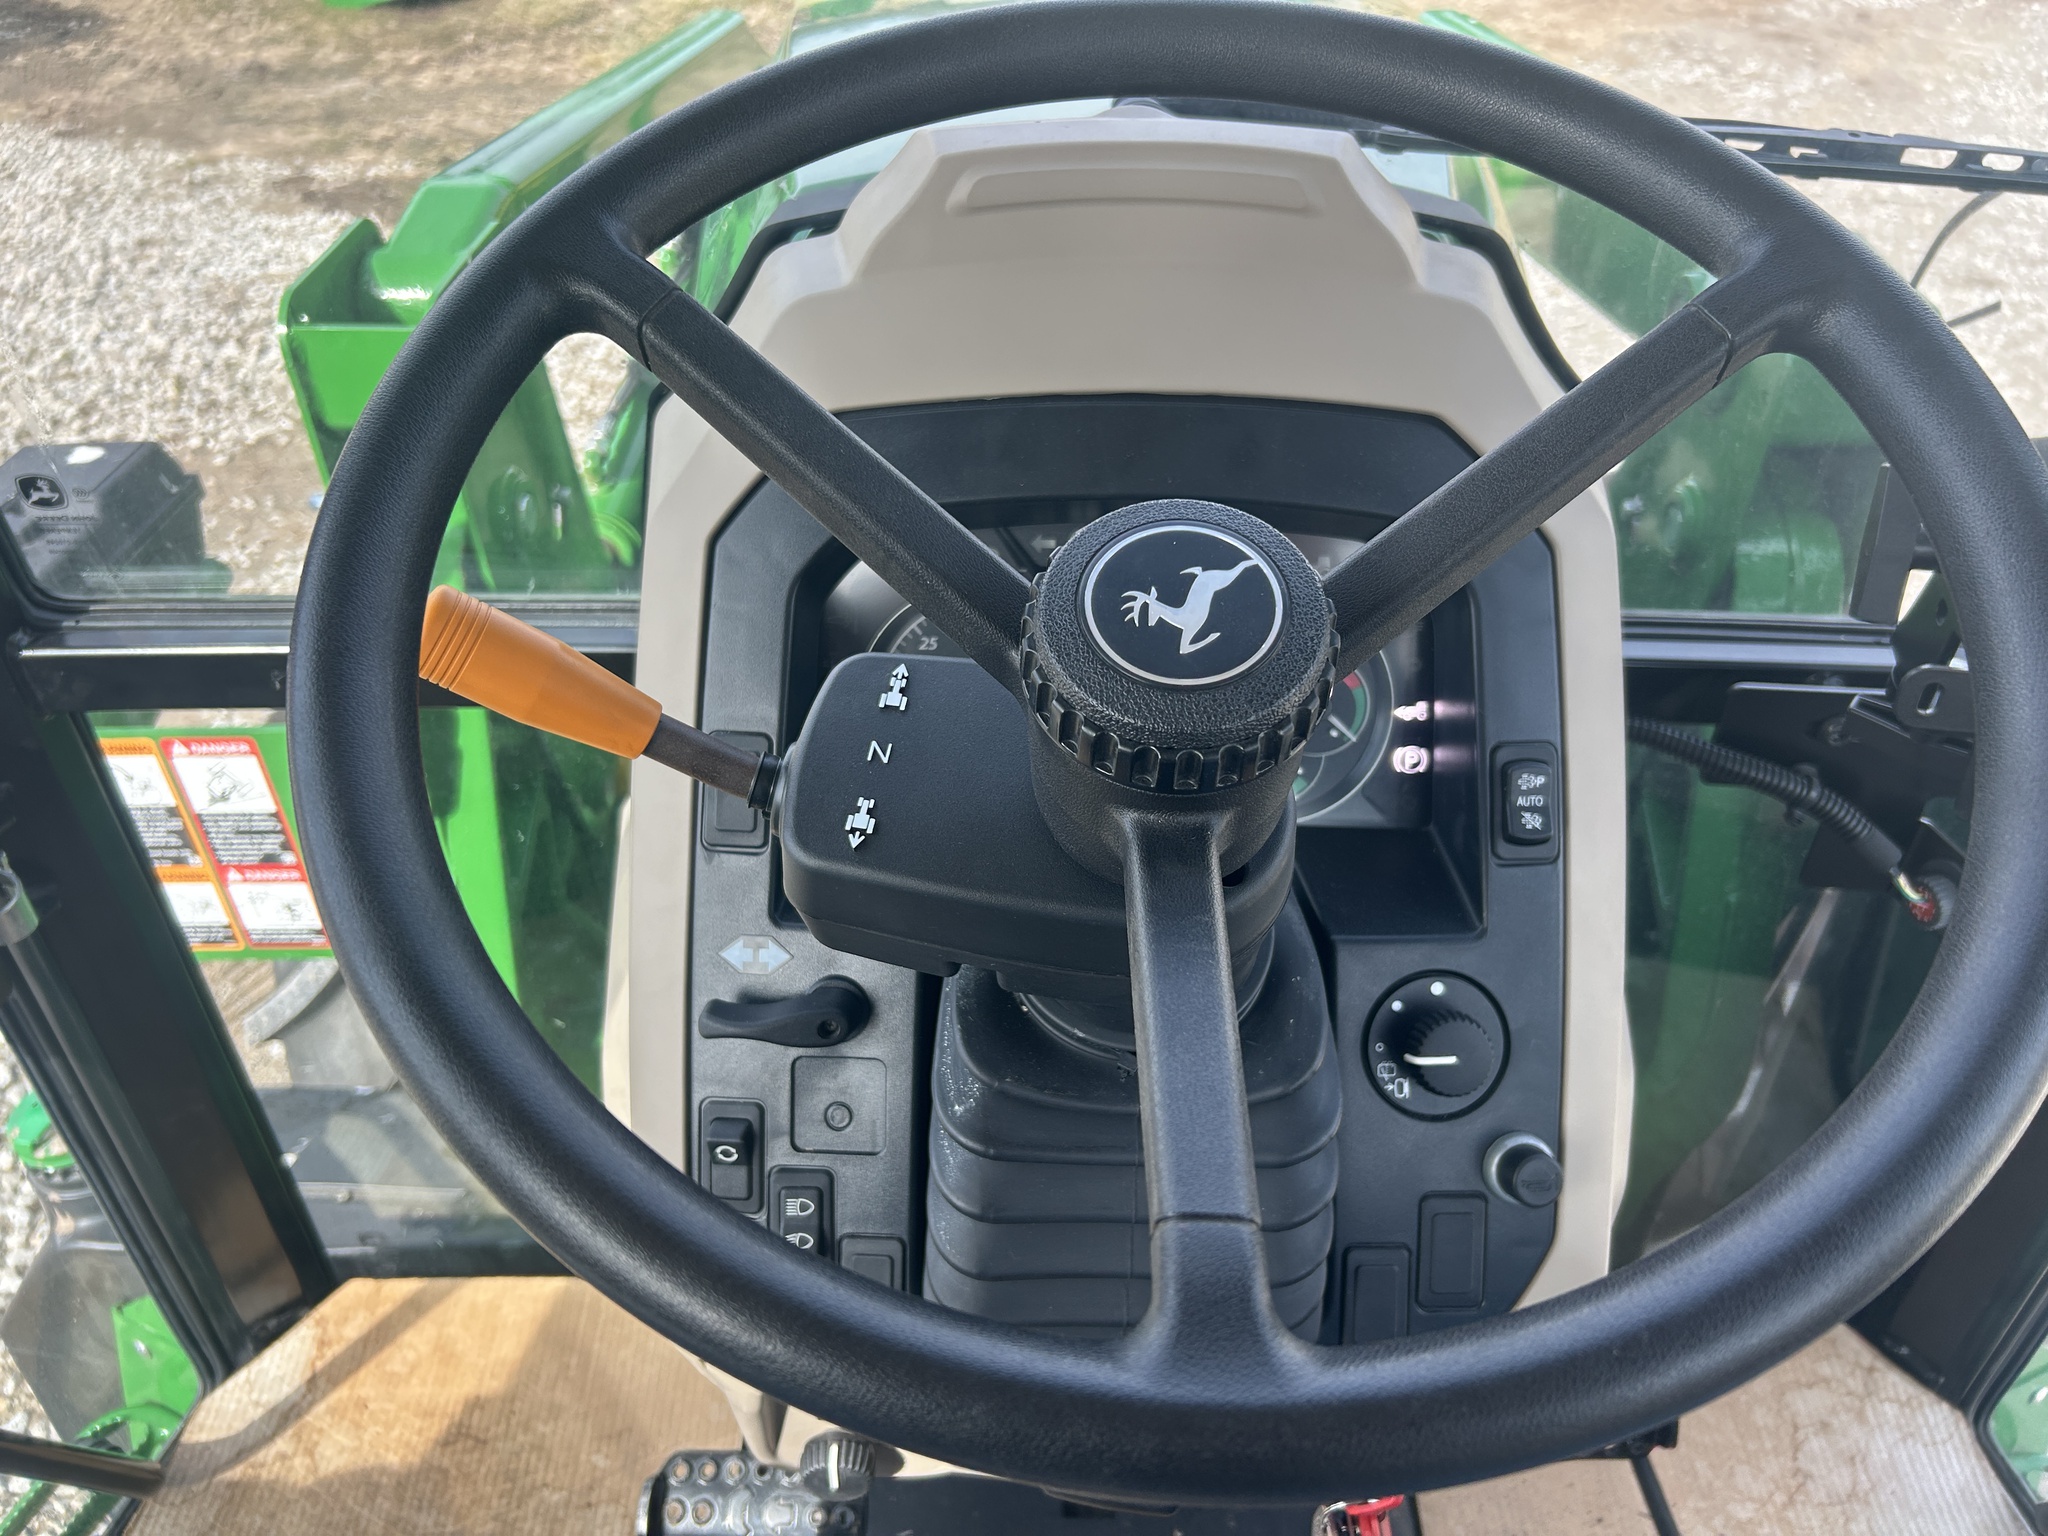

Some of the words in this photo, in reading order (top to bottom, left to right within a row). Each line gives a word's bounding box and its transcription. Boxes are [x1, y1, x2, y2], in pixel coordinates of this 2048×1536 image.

[919, 636, 939, 651] 25
[867, 740, 893, 764] N
[1516, 795, 1544, 807] AUTO
